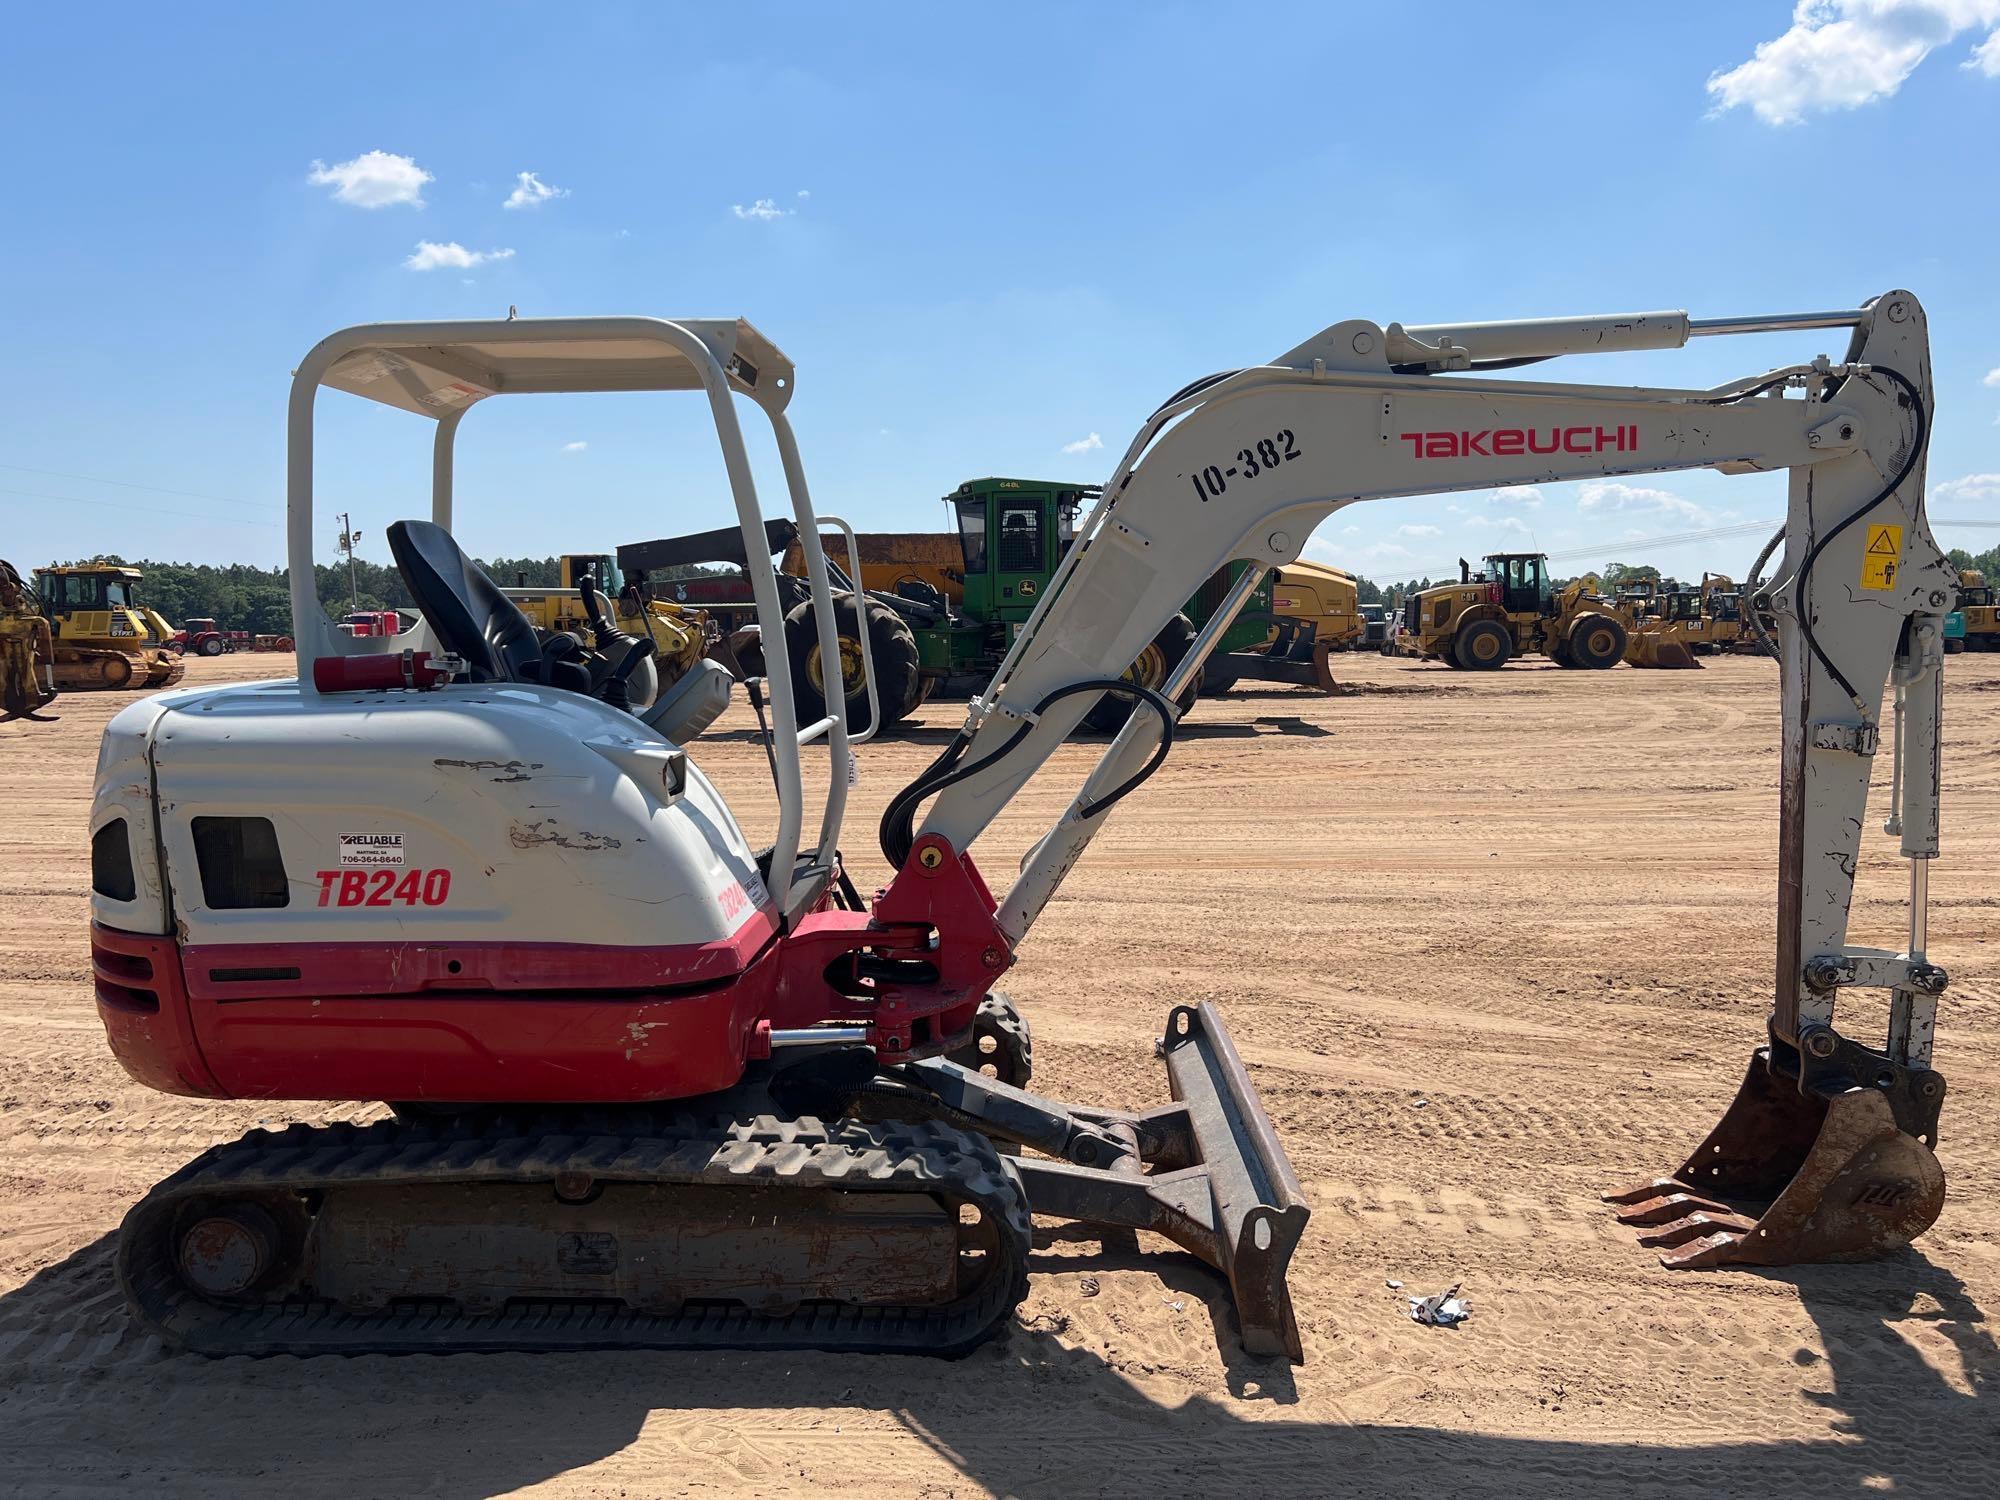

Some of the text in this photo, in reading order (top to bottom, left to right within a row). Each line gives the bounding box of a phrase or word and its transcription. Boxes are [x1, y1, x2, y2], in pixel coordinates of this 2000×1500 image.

[1191, 429, 1301, 502] 10-382
[1461, 592, 1475, 601] CAT
[1687, 621, 1702, 630] CAT
[351, 835, 402, 845] RELIABLE
[316, 869, 451, 907] TB240
